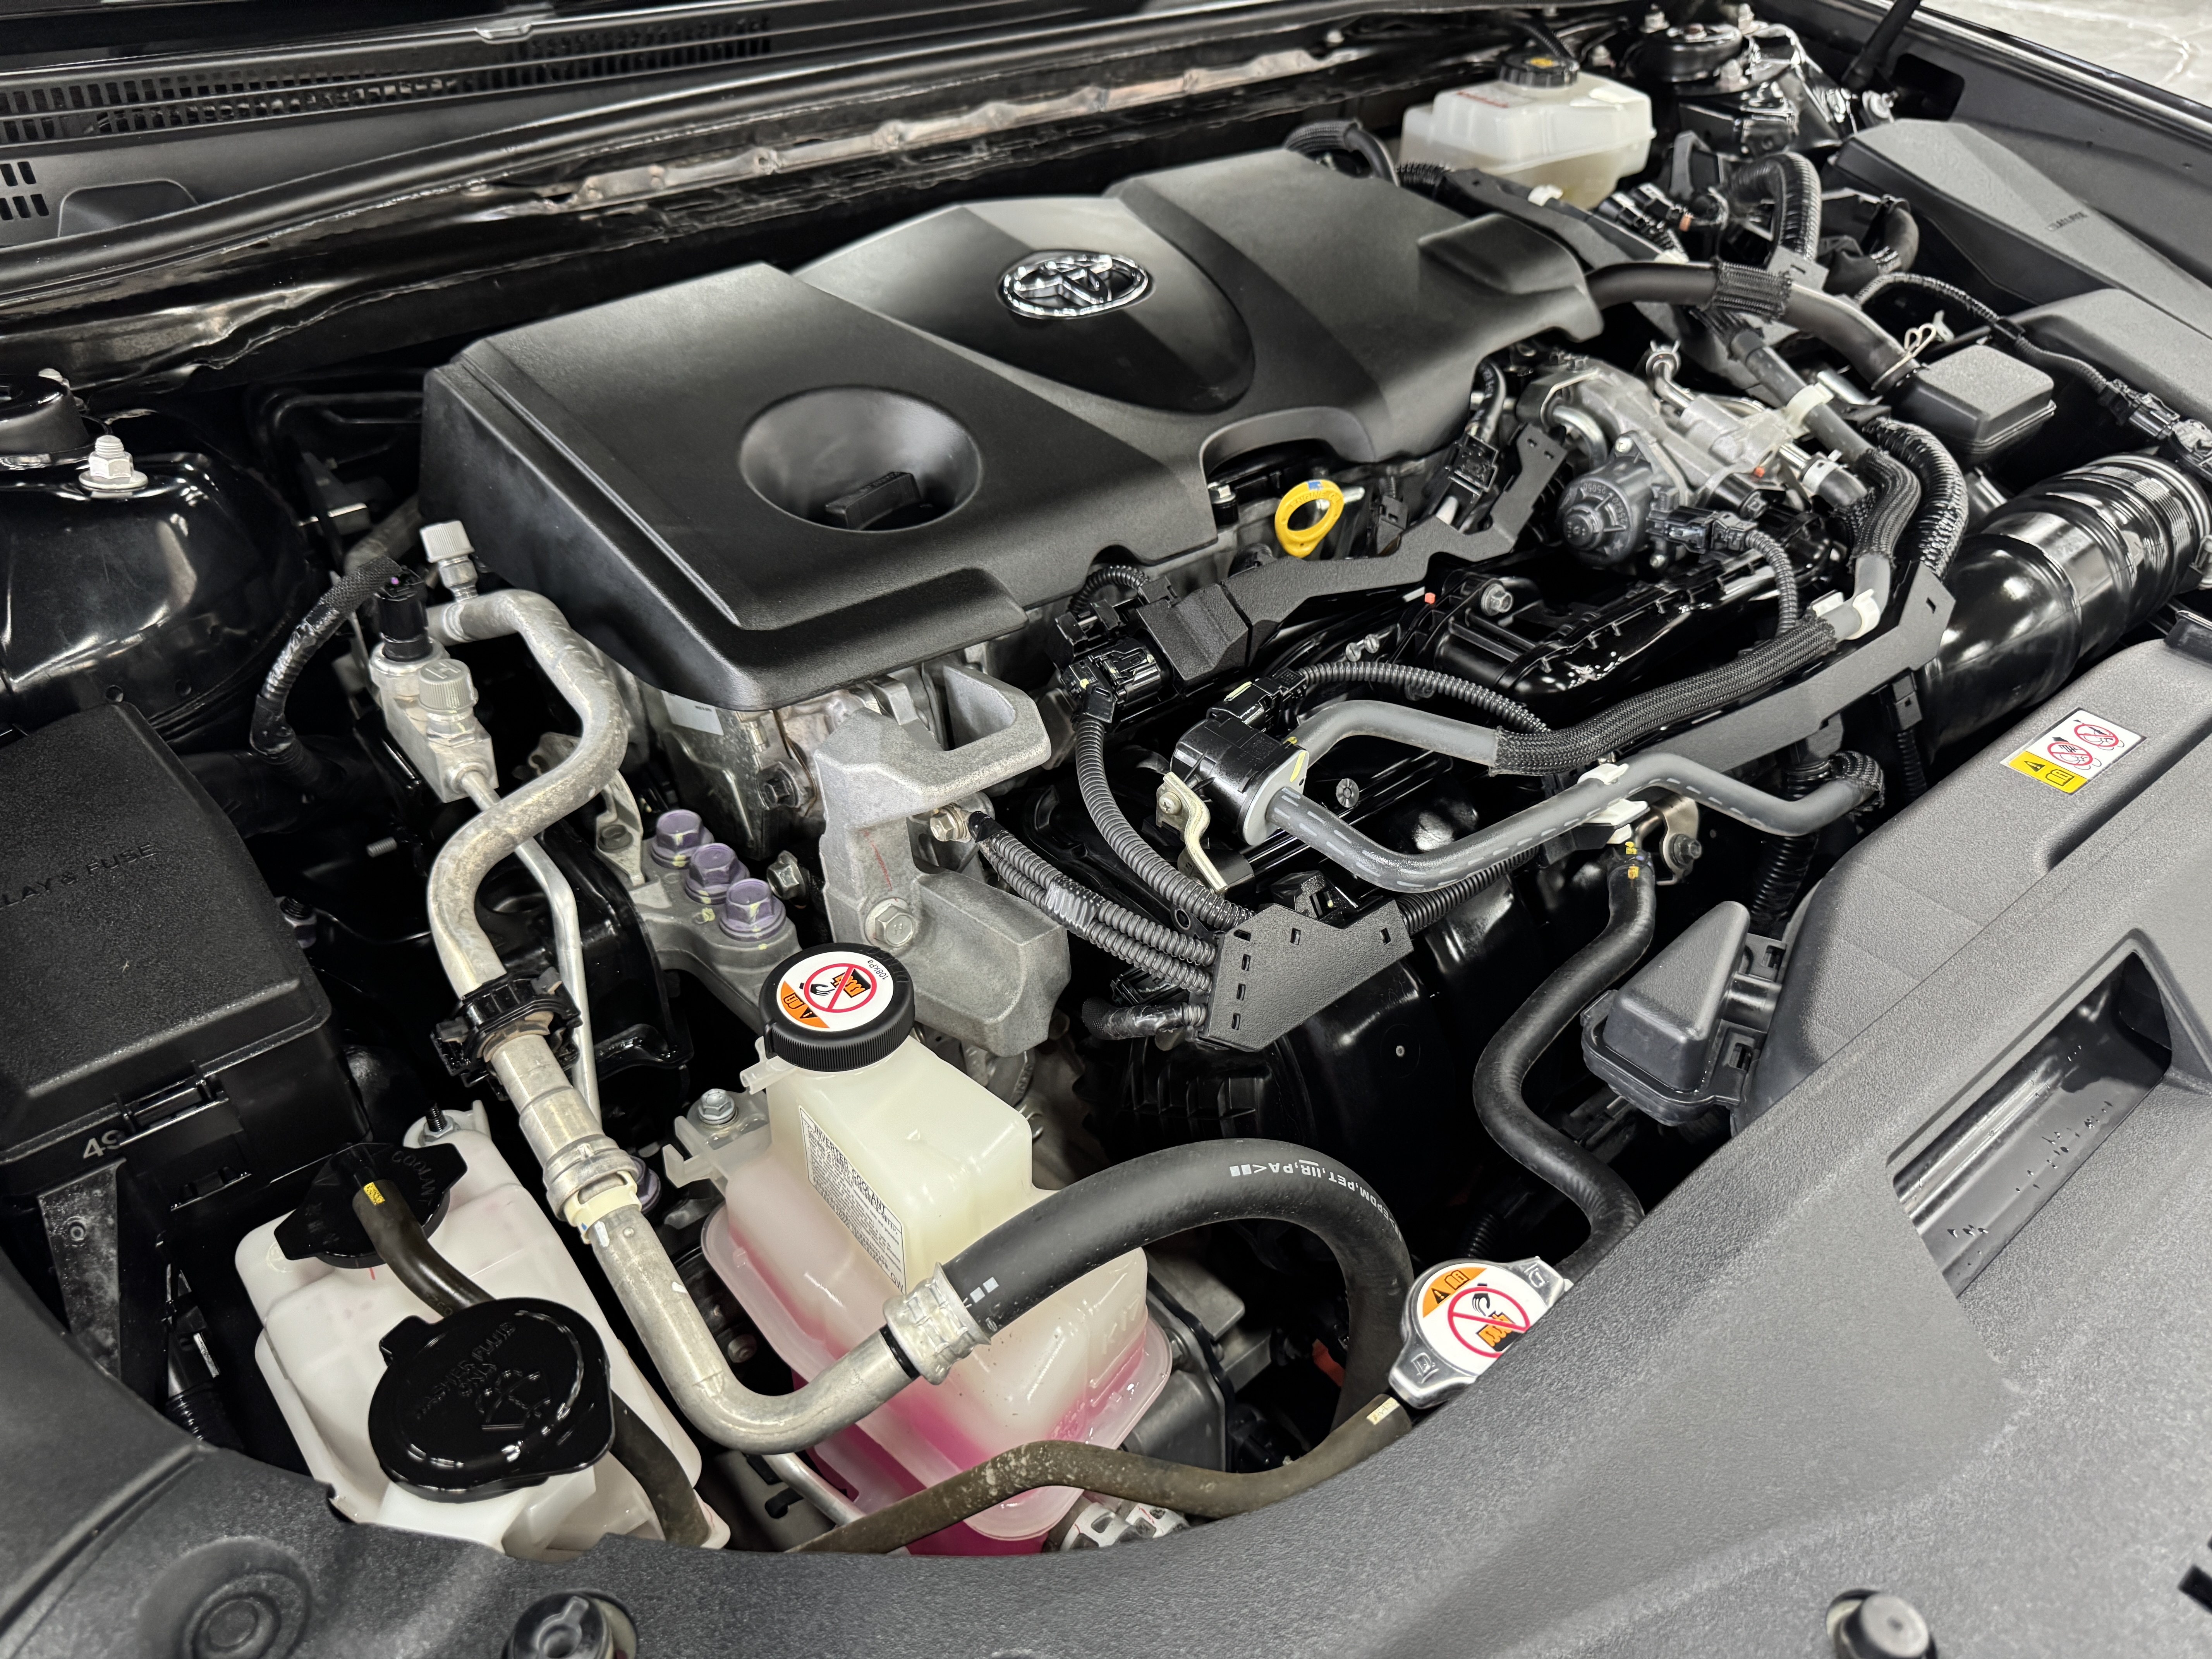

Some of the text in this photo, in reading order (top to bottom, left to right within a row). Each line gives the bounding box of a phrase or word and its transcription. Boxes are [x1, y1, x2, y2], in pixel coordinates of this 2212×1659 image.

[1290, 491, 1325, 510] ENGINE
[428, 661, 462, 679] H
[87, 843, 157, 875] FUSE
[867, 960, 889, 980] 108kPa
[392, 1151, 437, 1206] COOLANT
[814, 1123, 886, 1213] INVERTER COOLANT
